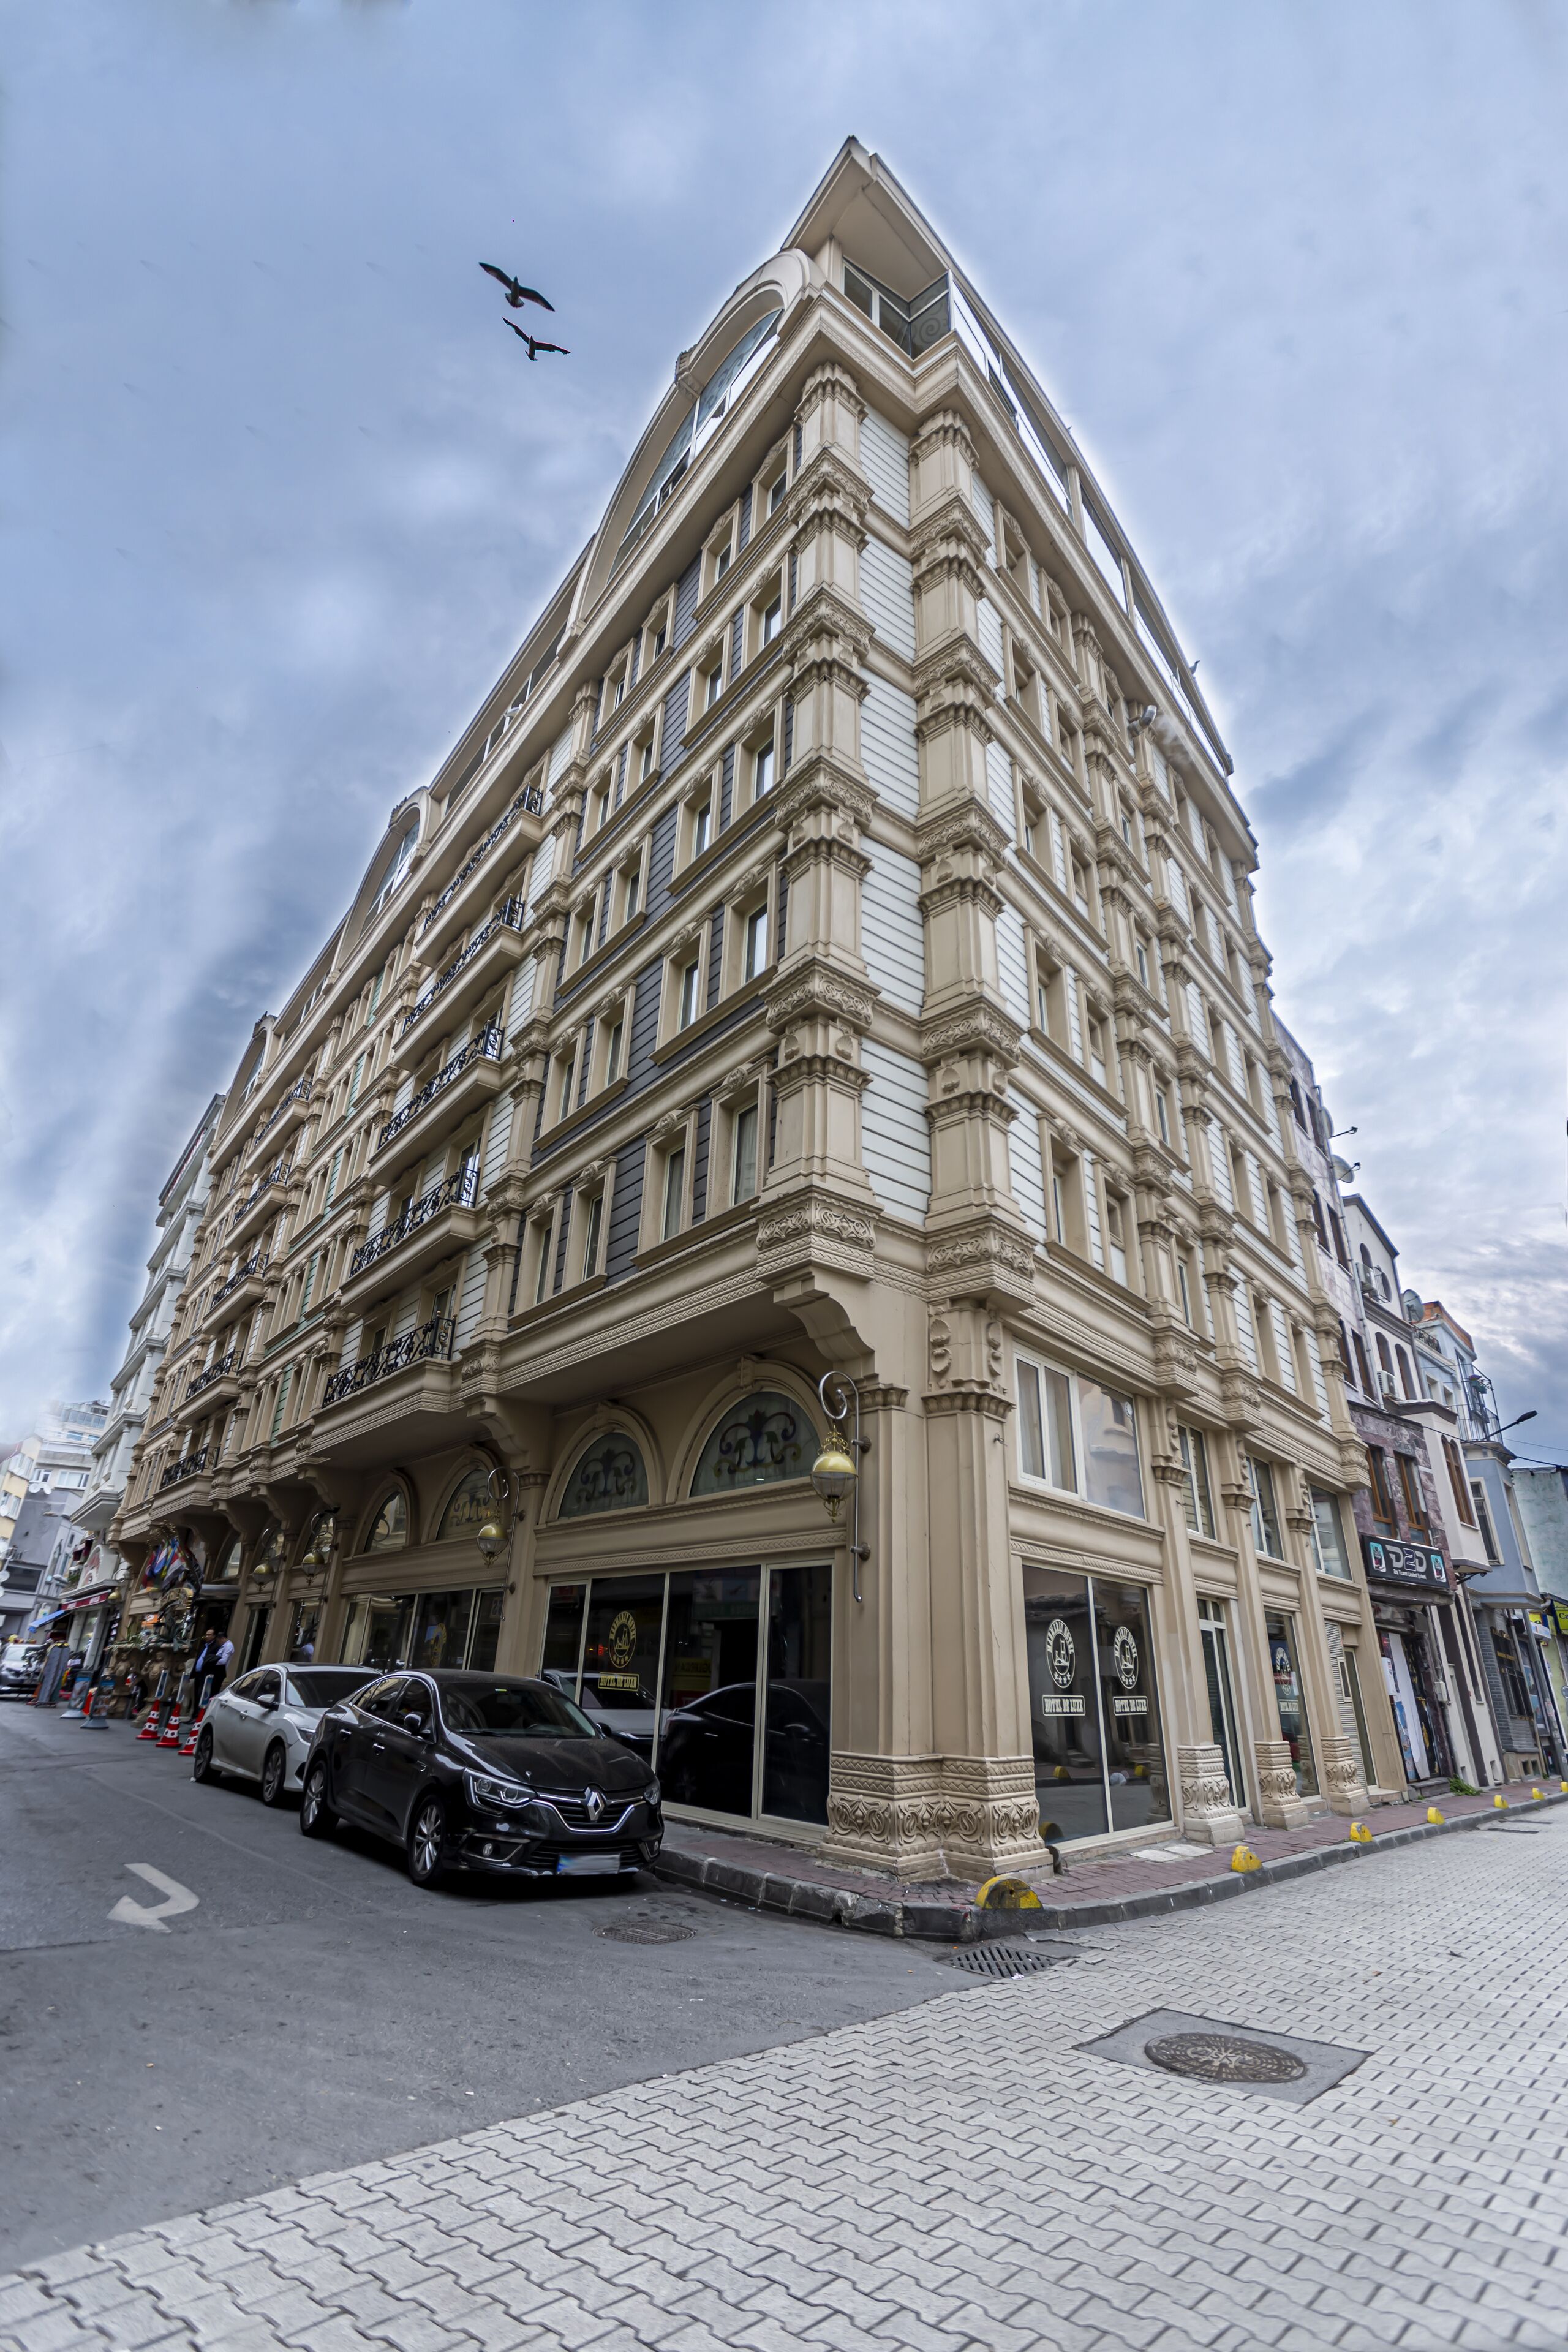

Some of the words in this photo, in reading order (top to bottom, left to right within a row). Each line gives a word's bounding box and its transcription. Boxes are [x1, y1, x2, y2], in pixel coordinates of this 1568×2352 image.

[1385, 1545, 1427, 1573] D2D
[600, 1675, 616, 1687] HOTEL
[624, 1676, 637, 1688] LUXE
[1044, 1698, 1062, 1713] HOTEL
[1062, 1698, 1070, 1713] DE
[1069, 1698, 1084, 1713] LUXE
[1115, 1699, 1130, 1713] HOTEL
[1136, 1699, 1147, 1711] LUXE
